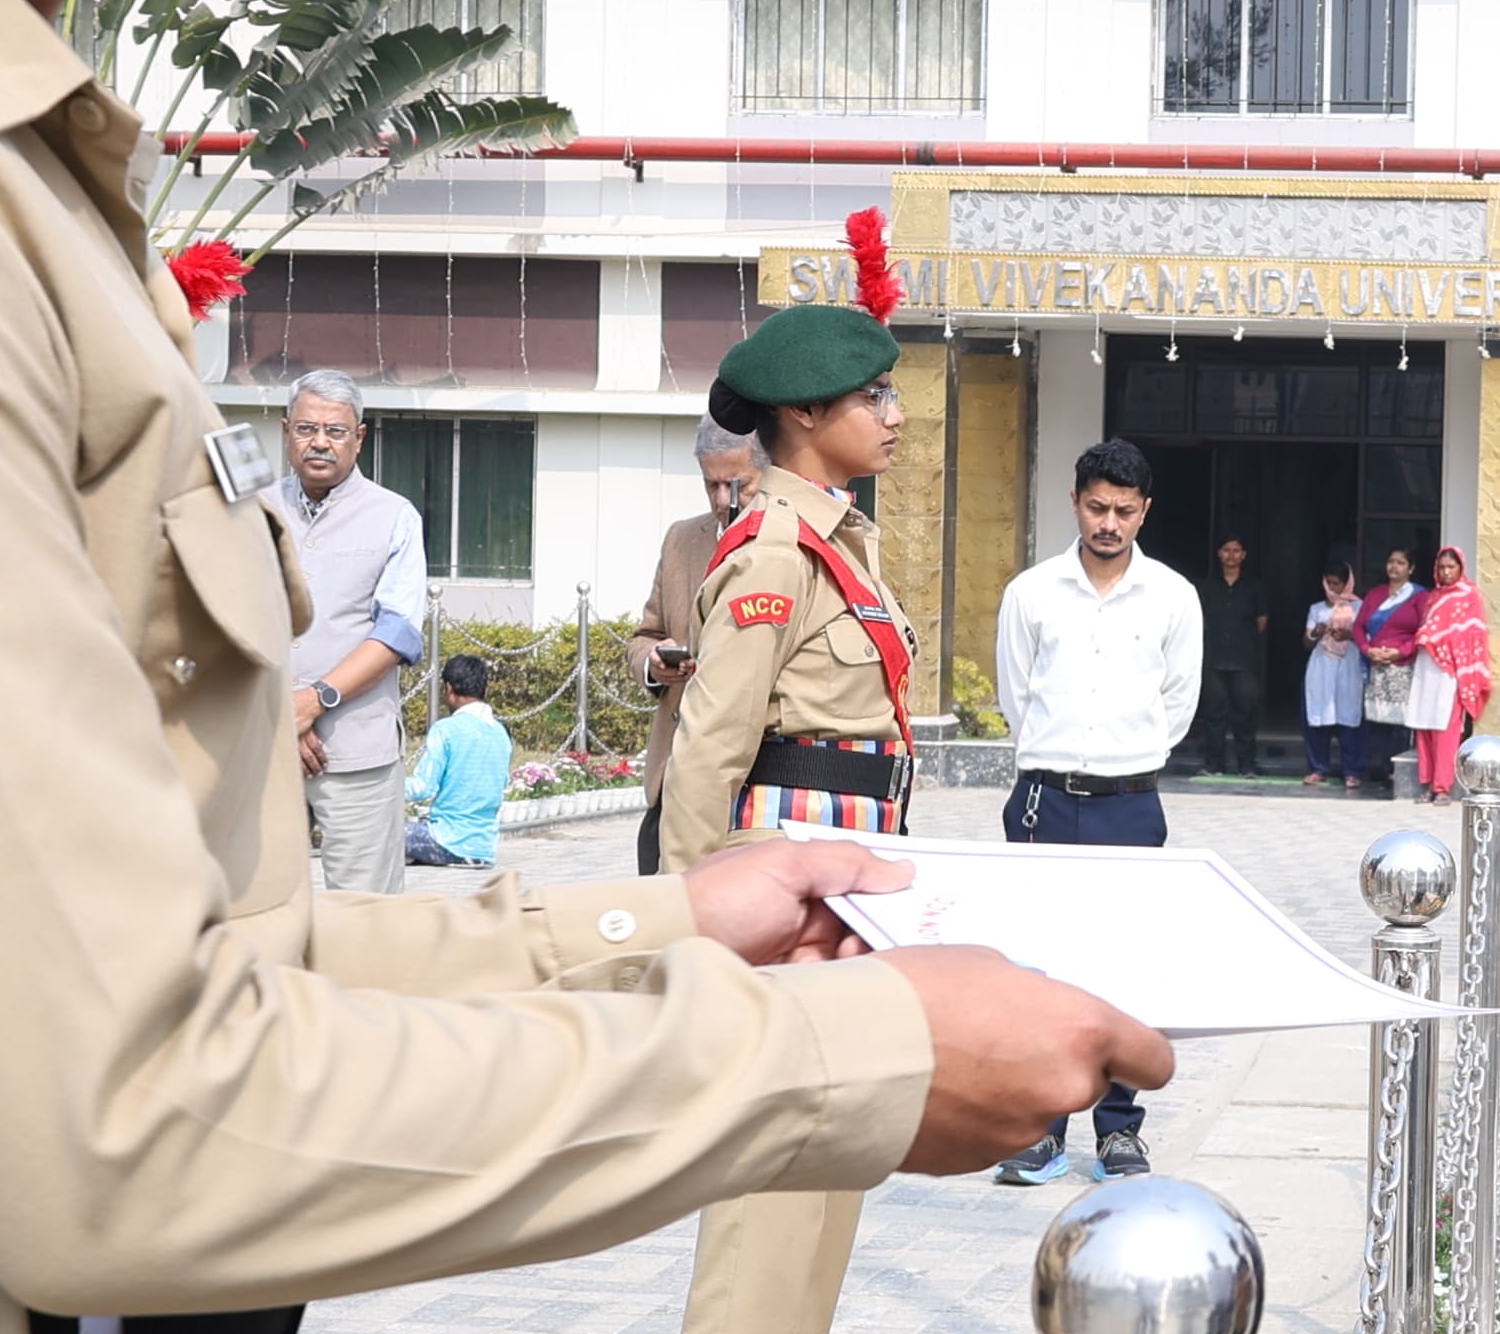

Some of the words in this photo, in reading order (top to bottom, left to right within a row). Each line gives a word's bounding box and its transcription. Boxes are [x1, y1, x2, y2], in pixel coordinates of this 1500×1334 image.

[787, 255, 947, 305] SWMI
[970, 258, 1325, 315] VIVEKANANDA
[740, 597, 785, 619] NCC
